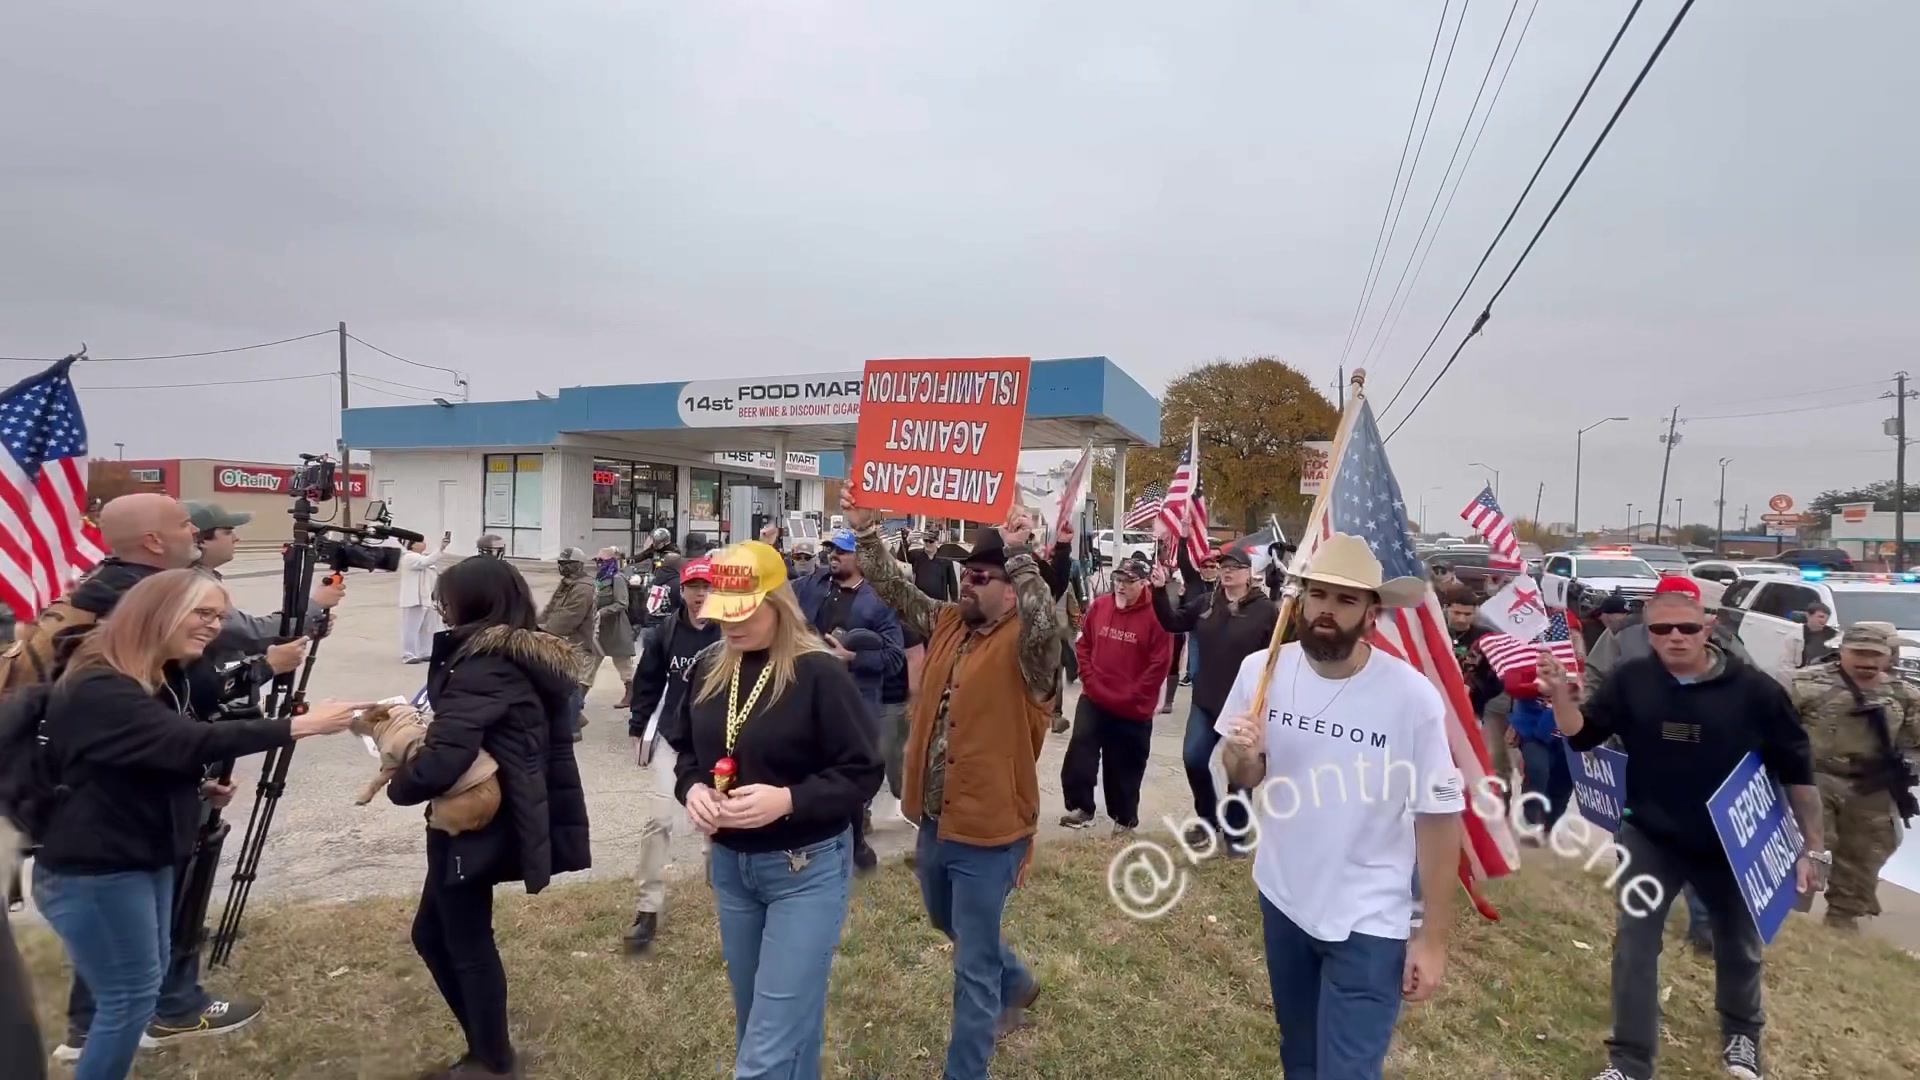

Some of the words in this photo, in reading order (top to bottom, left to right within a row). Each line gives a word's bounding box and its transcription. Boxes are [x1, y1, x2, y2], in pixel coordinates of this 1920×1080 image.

[684, 396, 734, 412] 14st
[738, 383, 800, 400] FOOD
[805, 380, 864, 398] MAR
[866, 370, 1021, 406] ISLAMIFICATION
[738, 407, 757, 418] BEER
[759, 406, 779, 417] WINE
[782, 405, 788, 417] &
[790, 404, 830, 416] DISCOUNT
[832, 403, 861, 415] CIGAR
[885, 419, 988, 455] AGAINST
[593, 471, 615, 485] OPEN
[789, 455, 816, 466] MART
[220, 469, 281, 490] O'Reilly
[862, 460, 1003, 505] AMERICANS
[1268, 709, 1387, 748] FREEDOM
[1581, 752, 1616, 788] BAN
[1728, 763, 1777, 848] DEPORT
[1745, 860, 1774, 917] ALL
